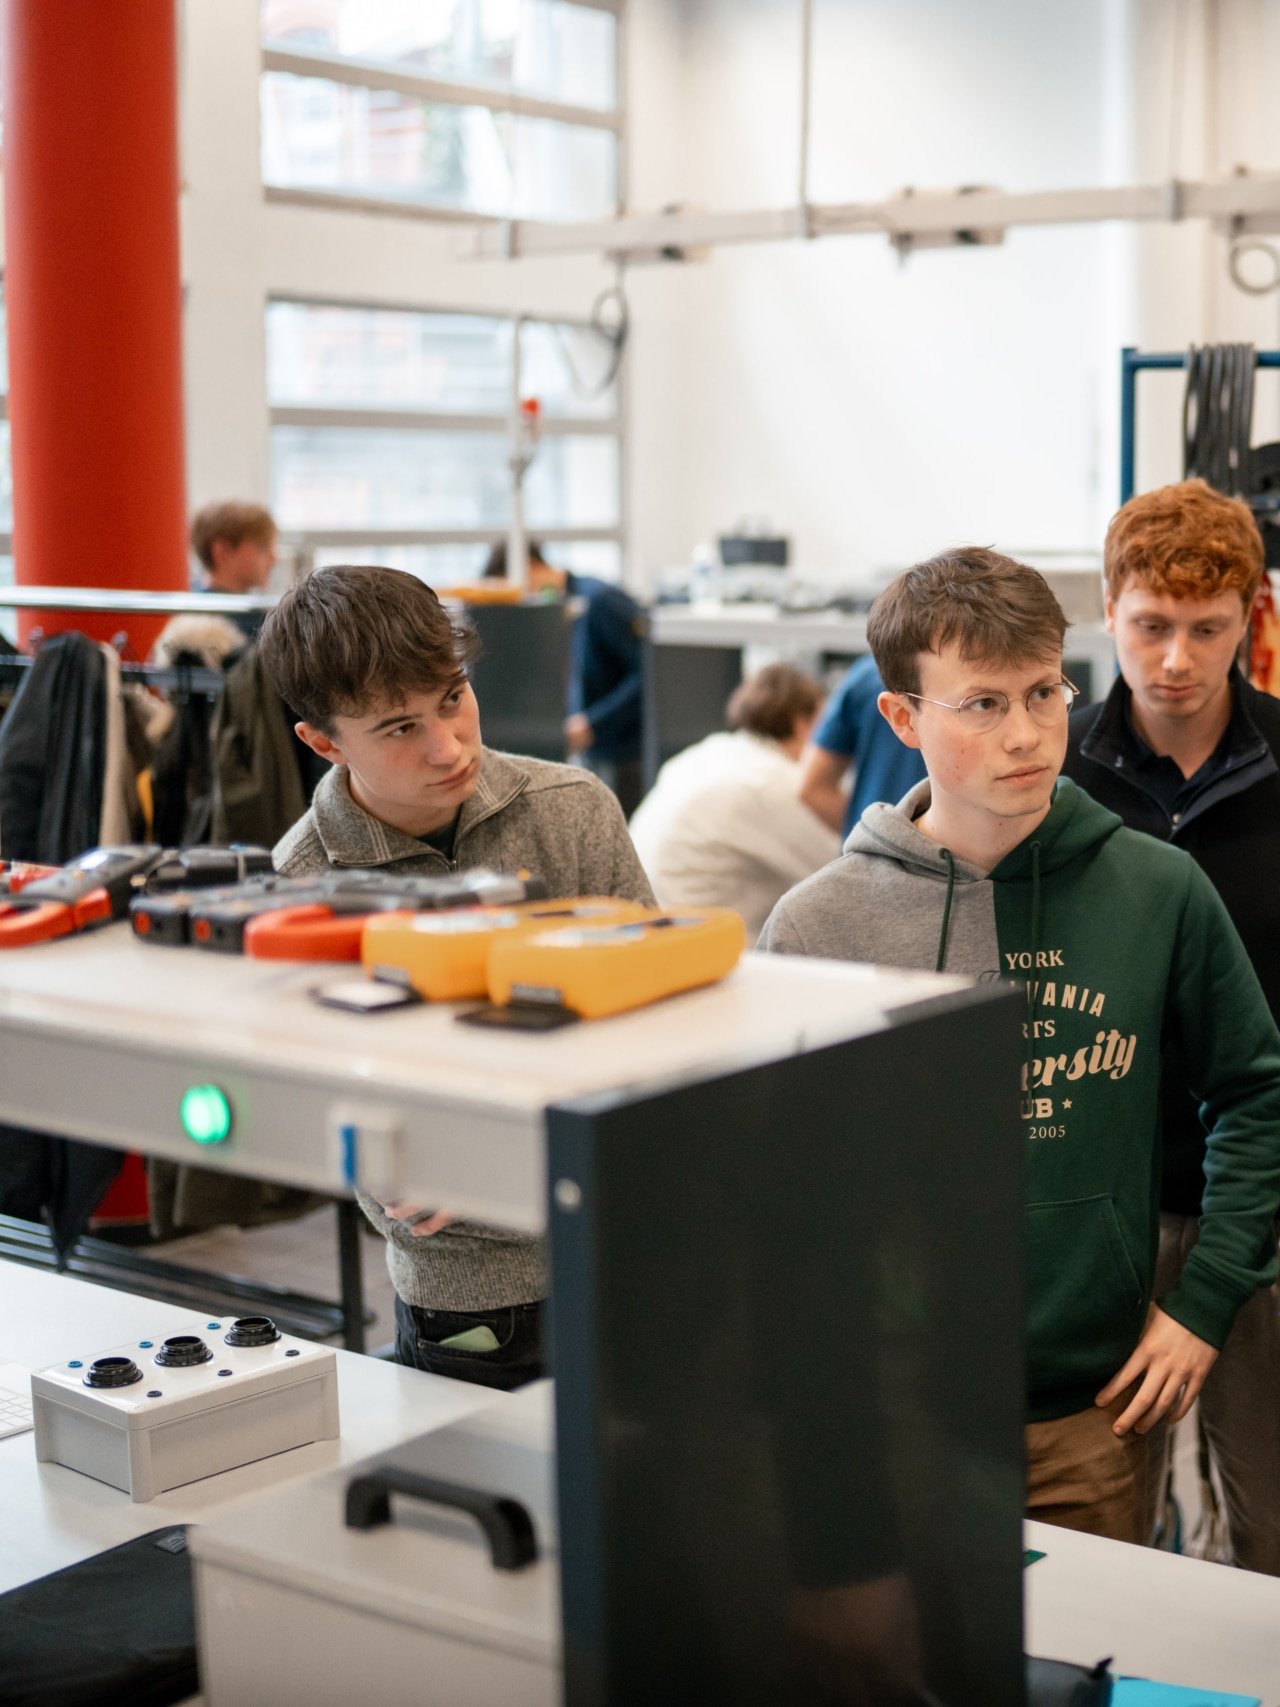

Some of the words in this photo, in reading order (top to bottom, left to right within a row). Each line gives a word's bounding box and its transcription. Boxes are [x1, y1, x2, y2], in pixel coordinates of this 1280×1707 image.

[1005, 950, 1064, 970] YORK
[1009, 980, 1106, 1017] VANIA
[1029, 1125, 1066, 1139] 2005
